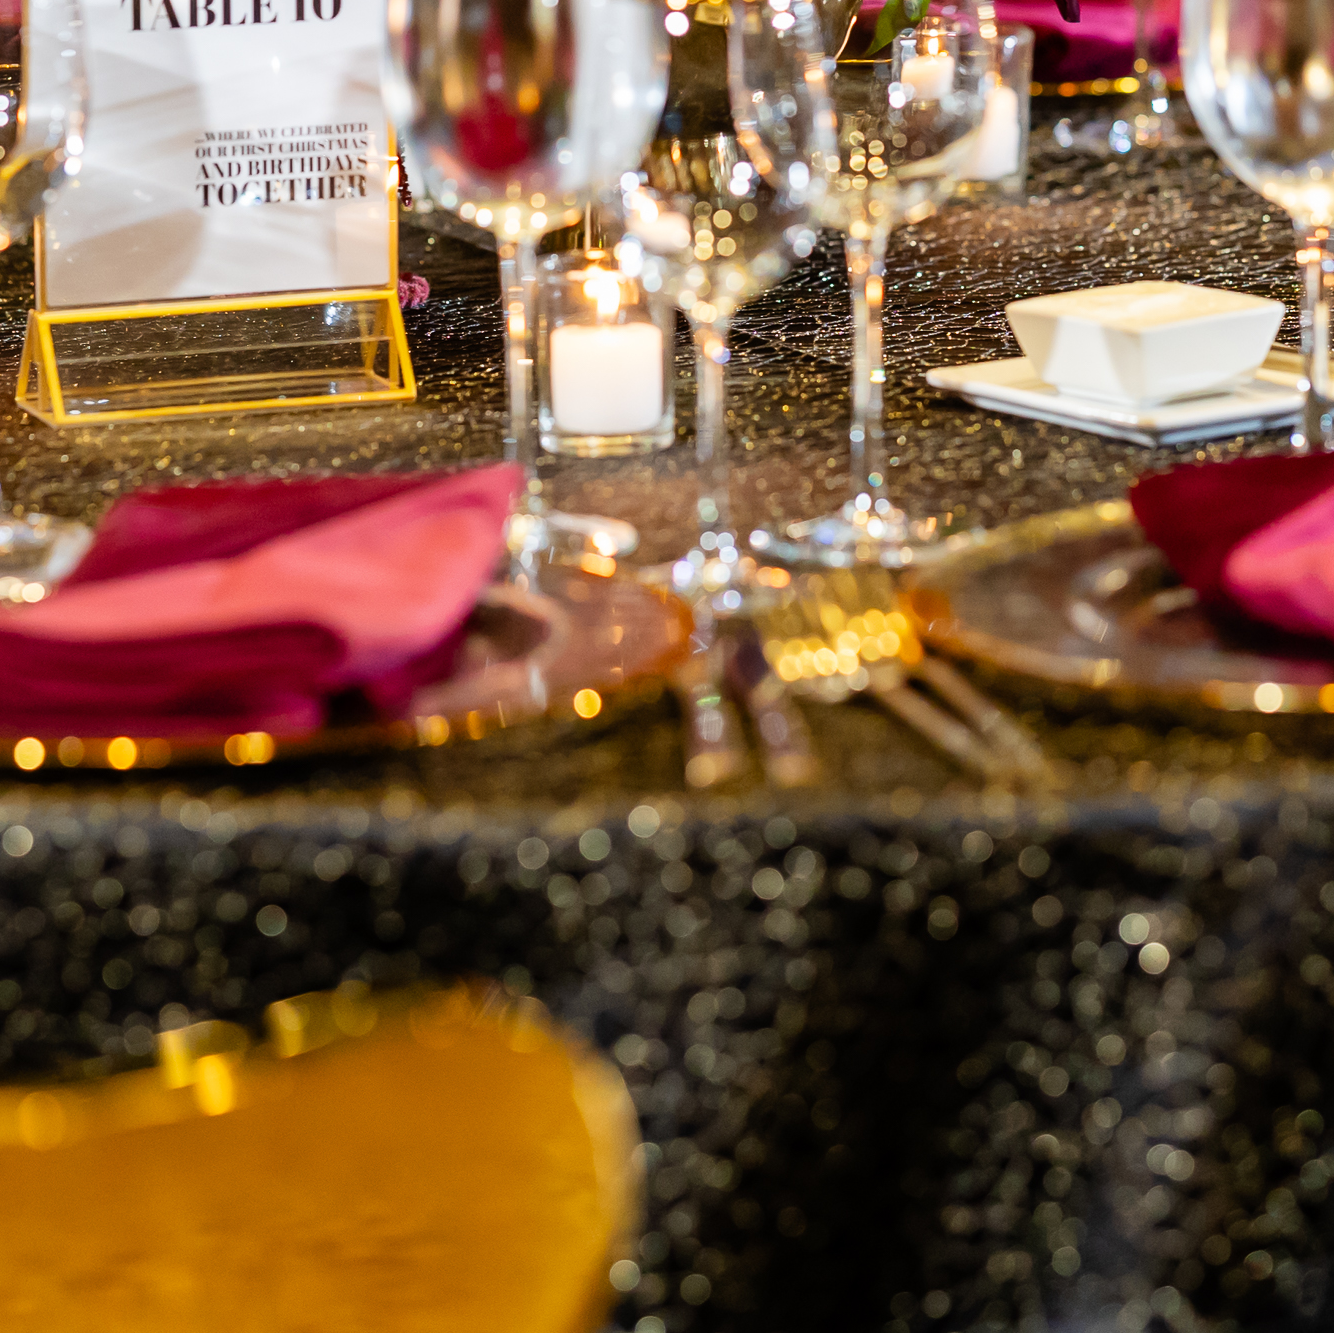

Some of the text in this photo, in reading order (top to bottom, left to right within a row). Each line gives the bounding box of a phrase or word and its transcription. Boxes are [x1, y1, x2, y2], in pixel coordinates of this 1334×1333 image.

[257, 127, 278, 139] WE
[281, 122, 368, 138] CELEBRATED
[195, 144, 228, 159] OUR
[231, 143, 276, 157] FIRST
[195, 154, 368, 180] AND BIRTHDAYS
